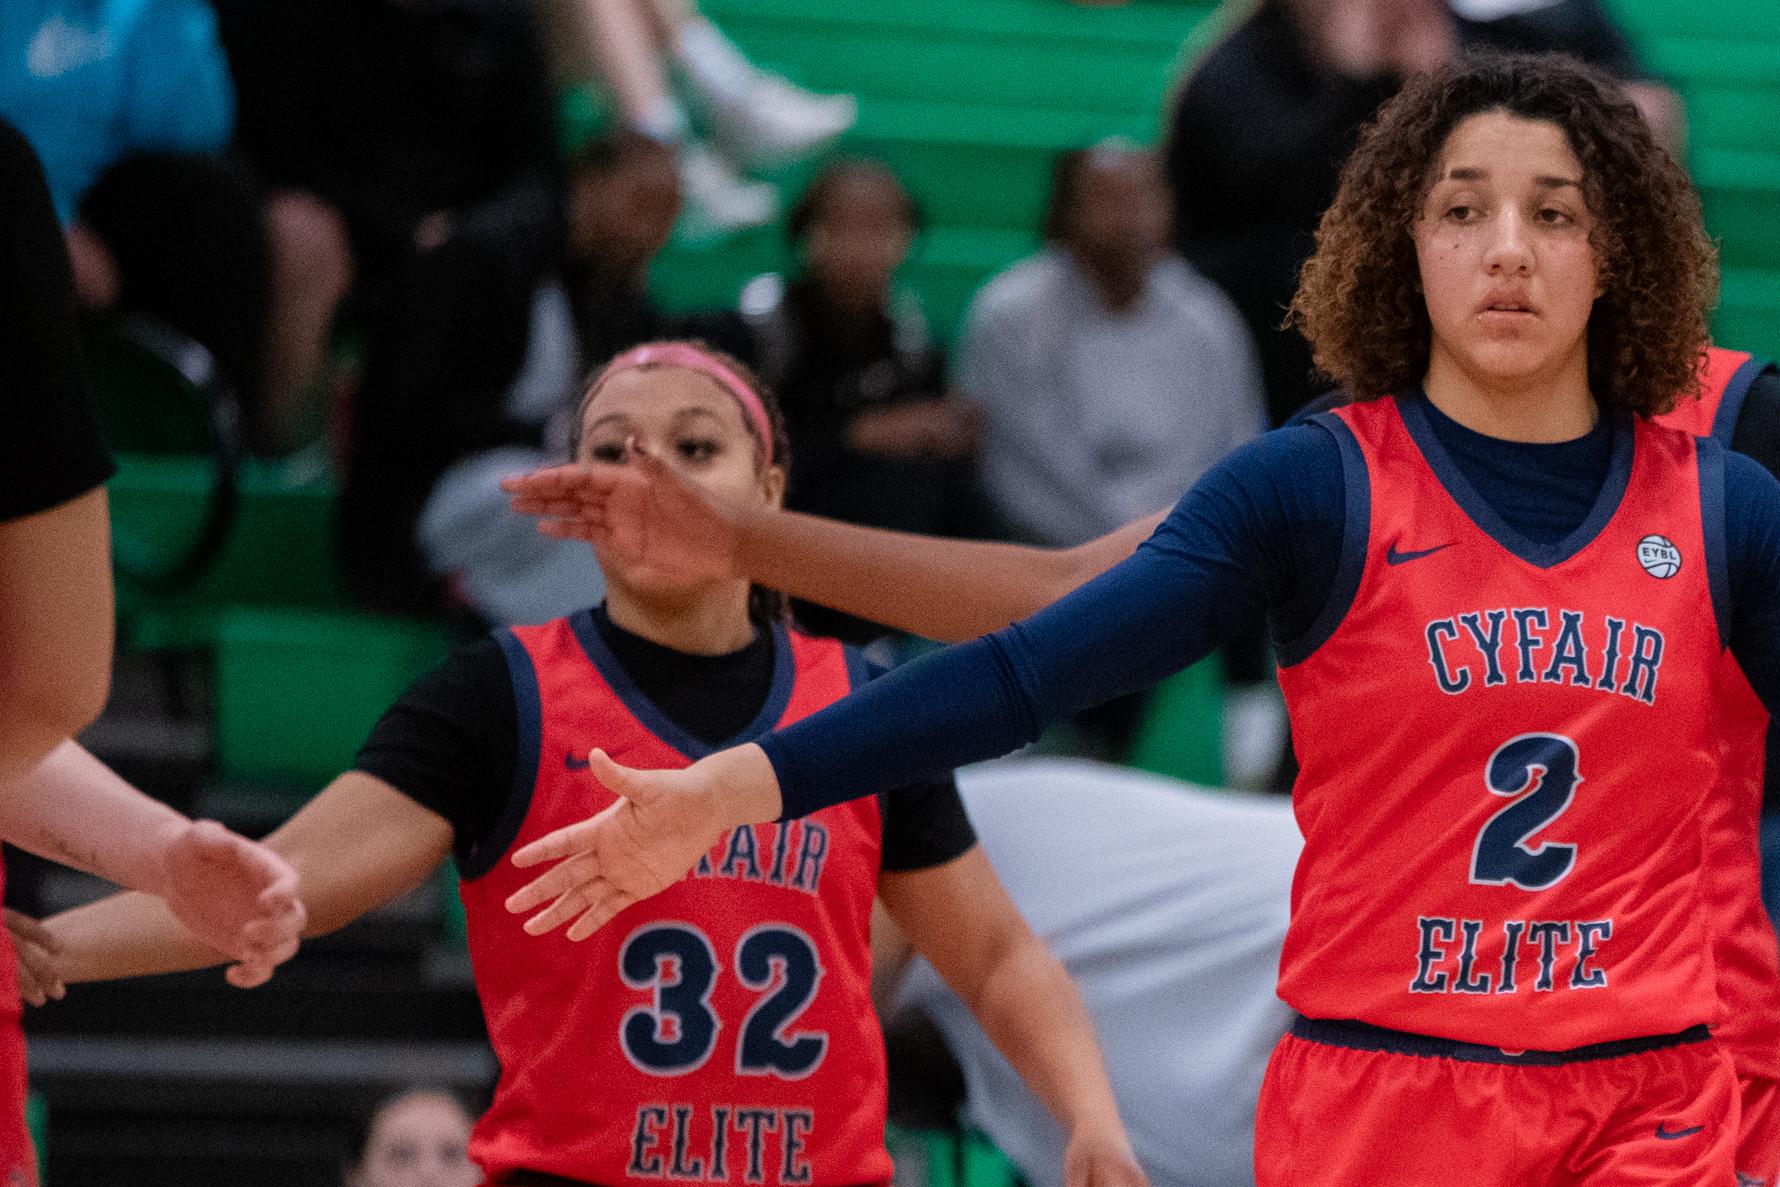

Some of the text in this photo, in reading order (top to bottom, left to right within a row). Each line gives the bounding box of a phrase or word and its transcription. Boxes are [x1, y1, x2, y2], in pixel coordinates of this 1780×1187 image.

[1642, 547, 1677, 560] EYBL
[1425, 607, 1665, 707] CYFAIR
[1468, 731, 1585, 892] 2
[695, 820, 830, 897] AIR
[1408, 915, 1613, 995] ELITE
[618, 920, 829, 1081] 32
[626, 1102, 815, 1186] ELITE
